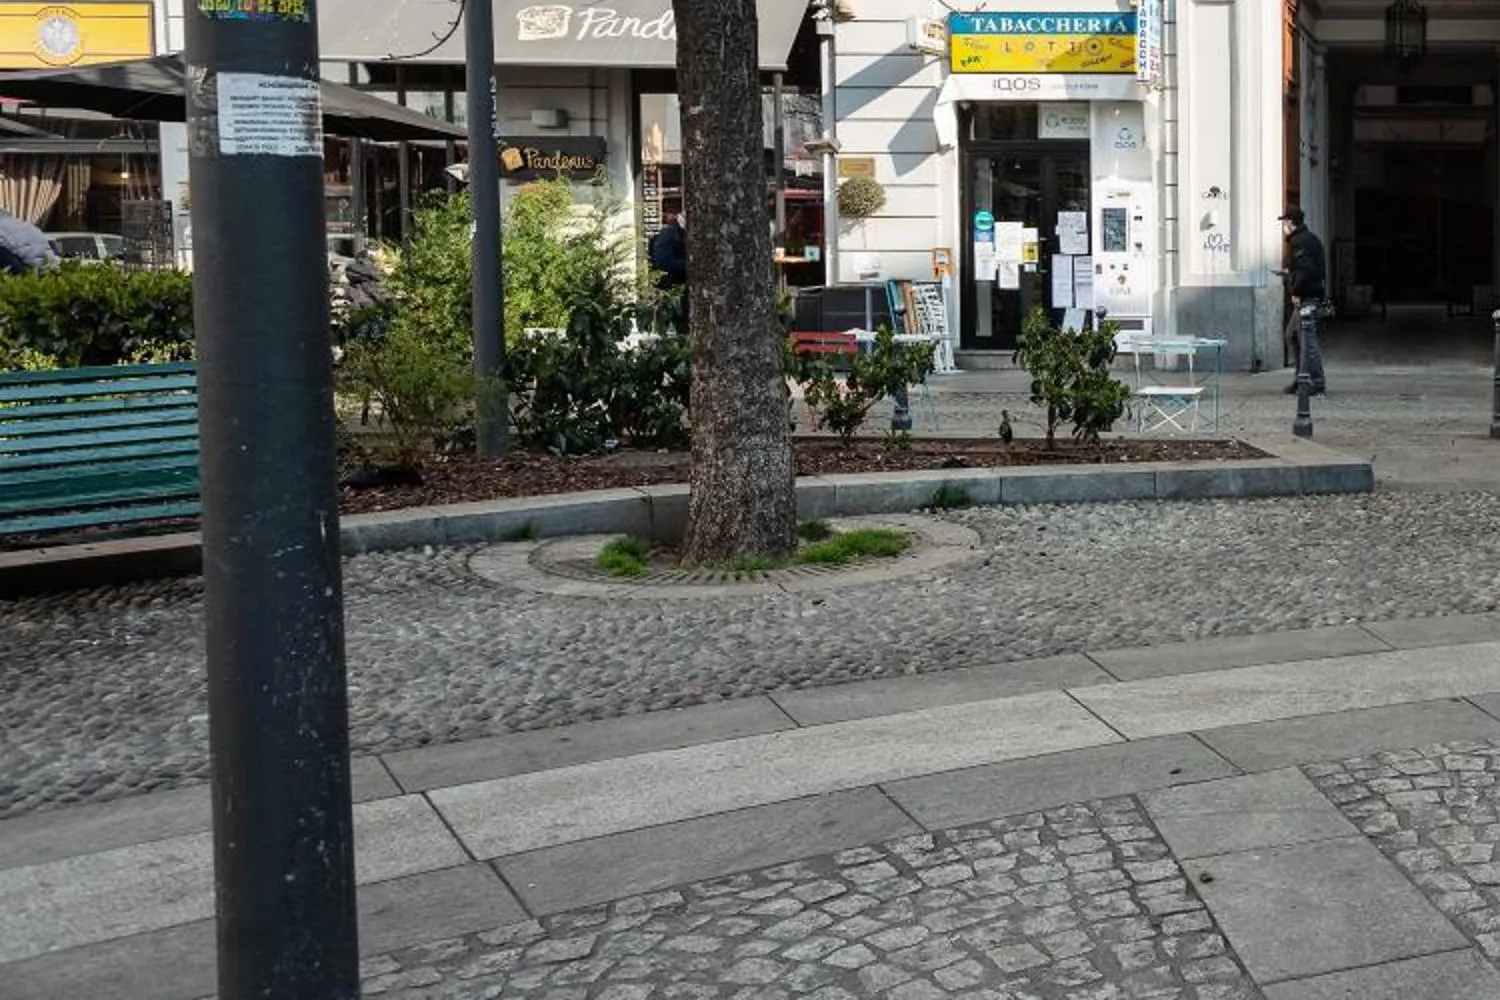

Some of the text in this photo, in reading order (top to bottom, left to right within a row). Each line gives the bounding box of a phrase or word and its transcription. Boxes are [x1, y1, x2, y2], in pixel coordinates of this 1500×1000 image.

[575, 7, 677, 41] Pand
[971, 16, 1128, 33] TABACCHERIA
[1004, 38, 1103, 56] LOTTO
